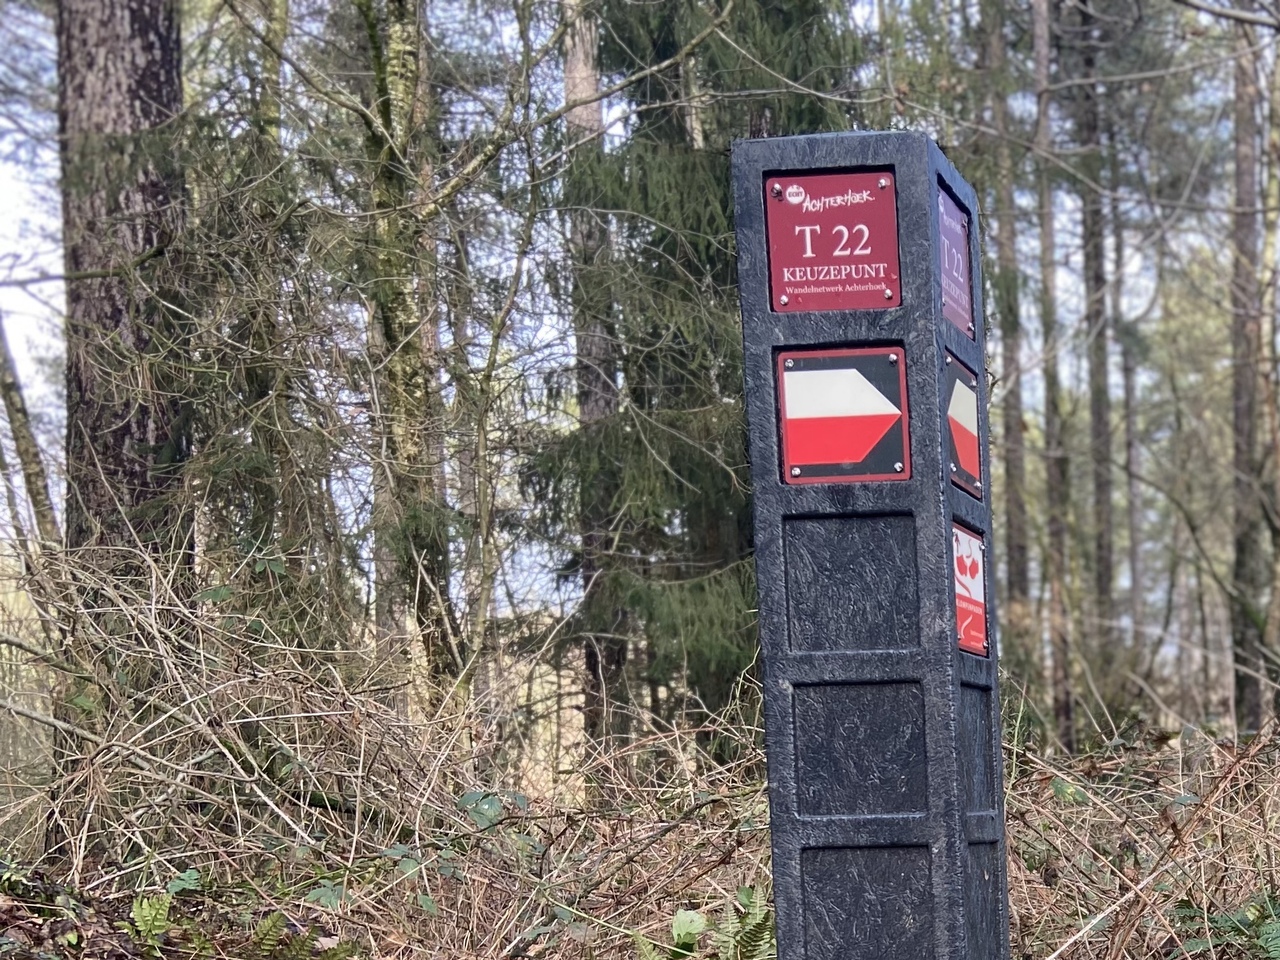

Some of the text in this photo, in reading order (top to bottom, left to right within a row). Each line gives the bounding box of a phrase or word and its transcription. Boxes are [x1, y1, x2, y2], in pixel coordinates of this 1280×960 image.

[795, 224, 872, 258] T 22
[783, 263, 887, 281] KEUZEPUNT
[942, 236, 964, 283] T 22
[785, 281, 887, 294] Wandelnetwerk Achterhoek
